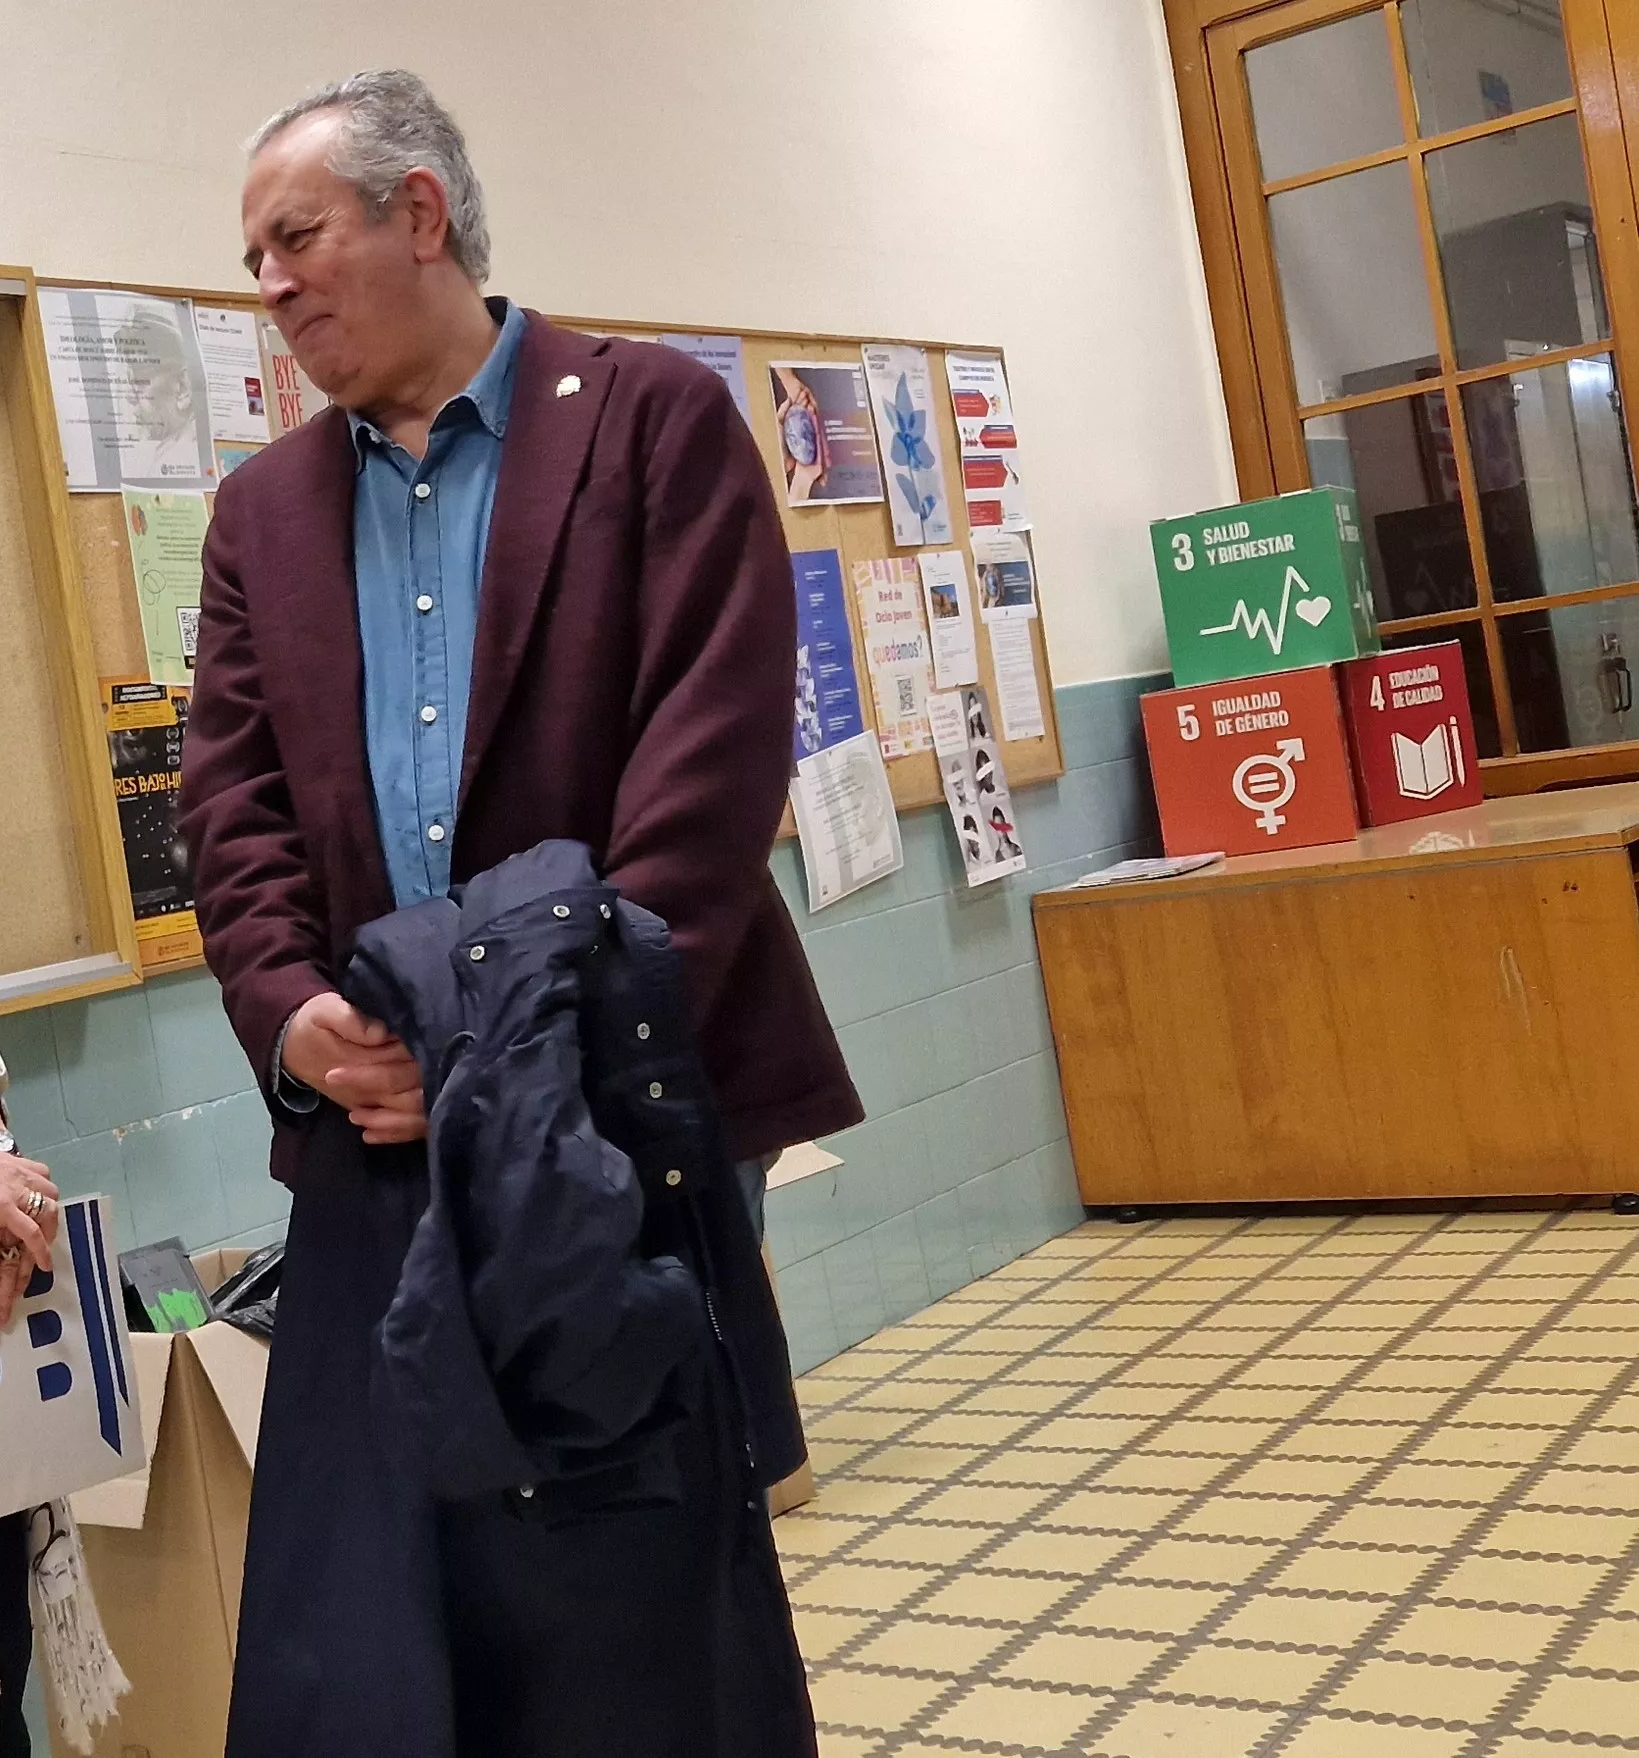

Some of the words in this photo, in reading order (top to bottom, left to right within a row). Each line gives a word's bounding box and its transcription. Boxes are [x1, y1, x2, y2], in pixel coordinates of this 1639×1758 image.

[272, 355, 300, 390] BYE
[1203, 521, 1250, 545] SALUD
[1172, 533, 1195, 571] 3
[1206, 549, 1216, 565] Y
[1217, 534, 1296, 564] BIENESTAR
[878, 590, 892, 601] Red
[895, 588, 902, 600] de
[1388, 664, 1439, 689] EDUCACIÓN
[1212, 691, 1281, 716] IGUALDAD
[1370, 675, 1385, 711] 4
[1392, 692, 1406, 709] DE
[1405, 685, 1443, 706] CALIDAD
[1176, 704, 1200, 741] 5
[1215, 719, 1234, 736] DE
[1235, 710, 1289, 733] GÉNERO
[114, 777, 137, 796] RES
